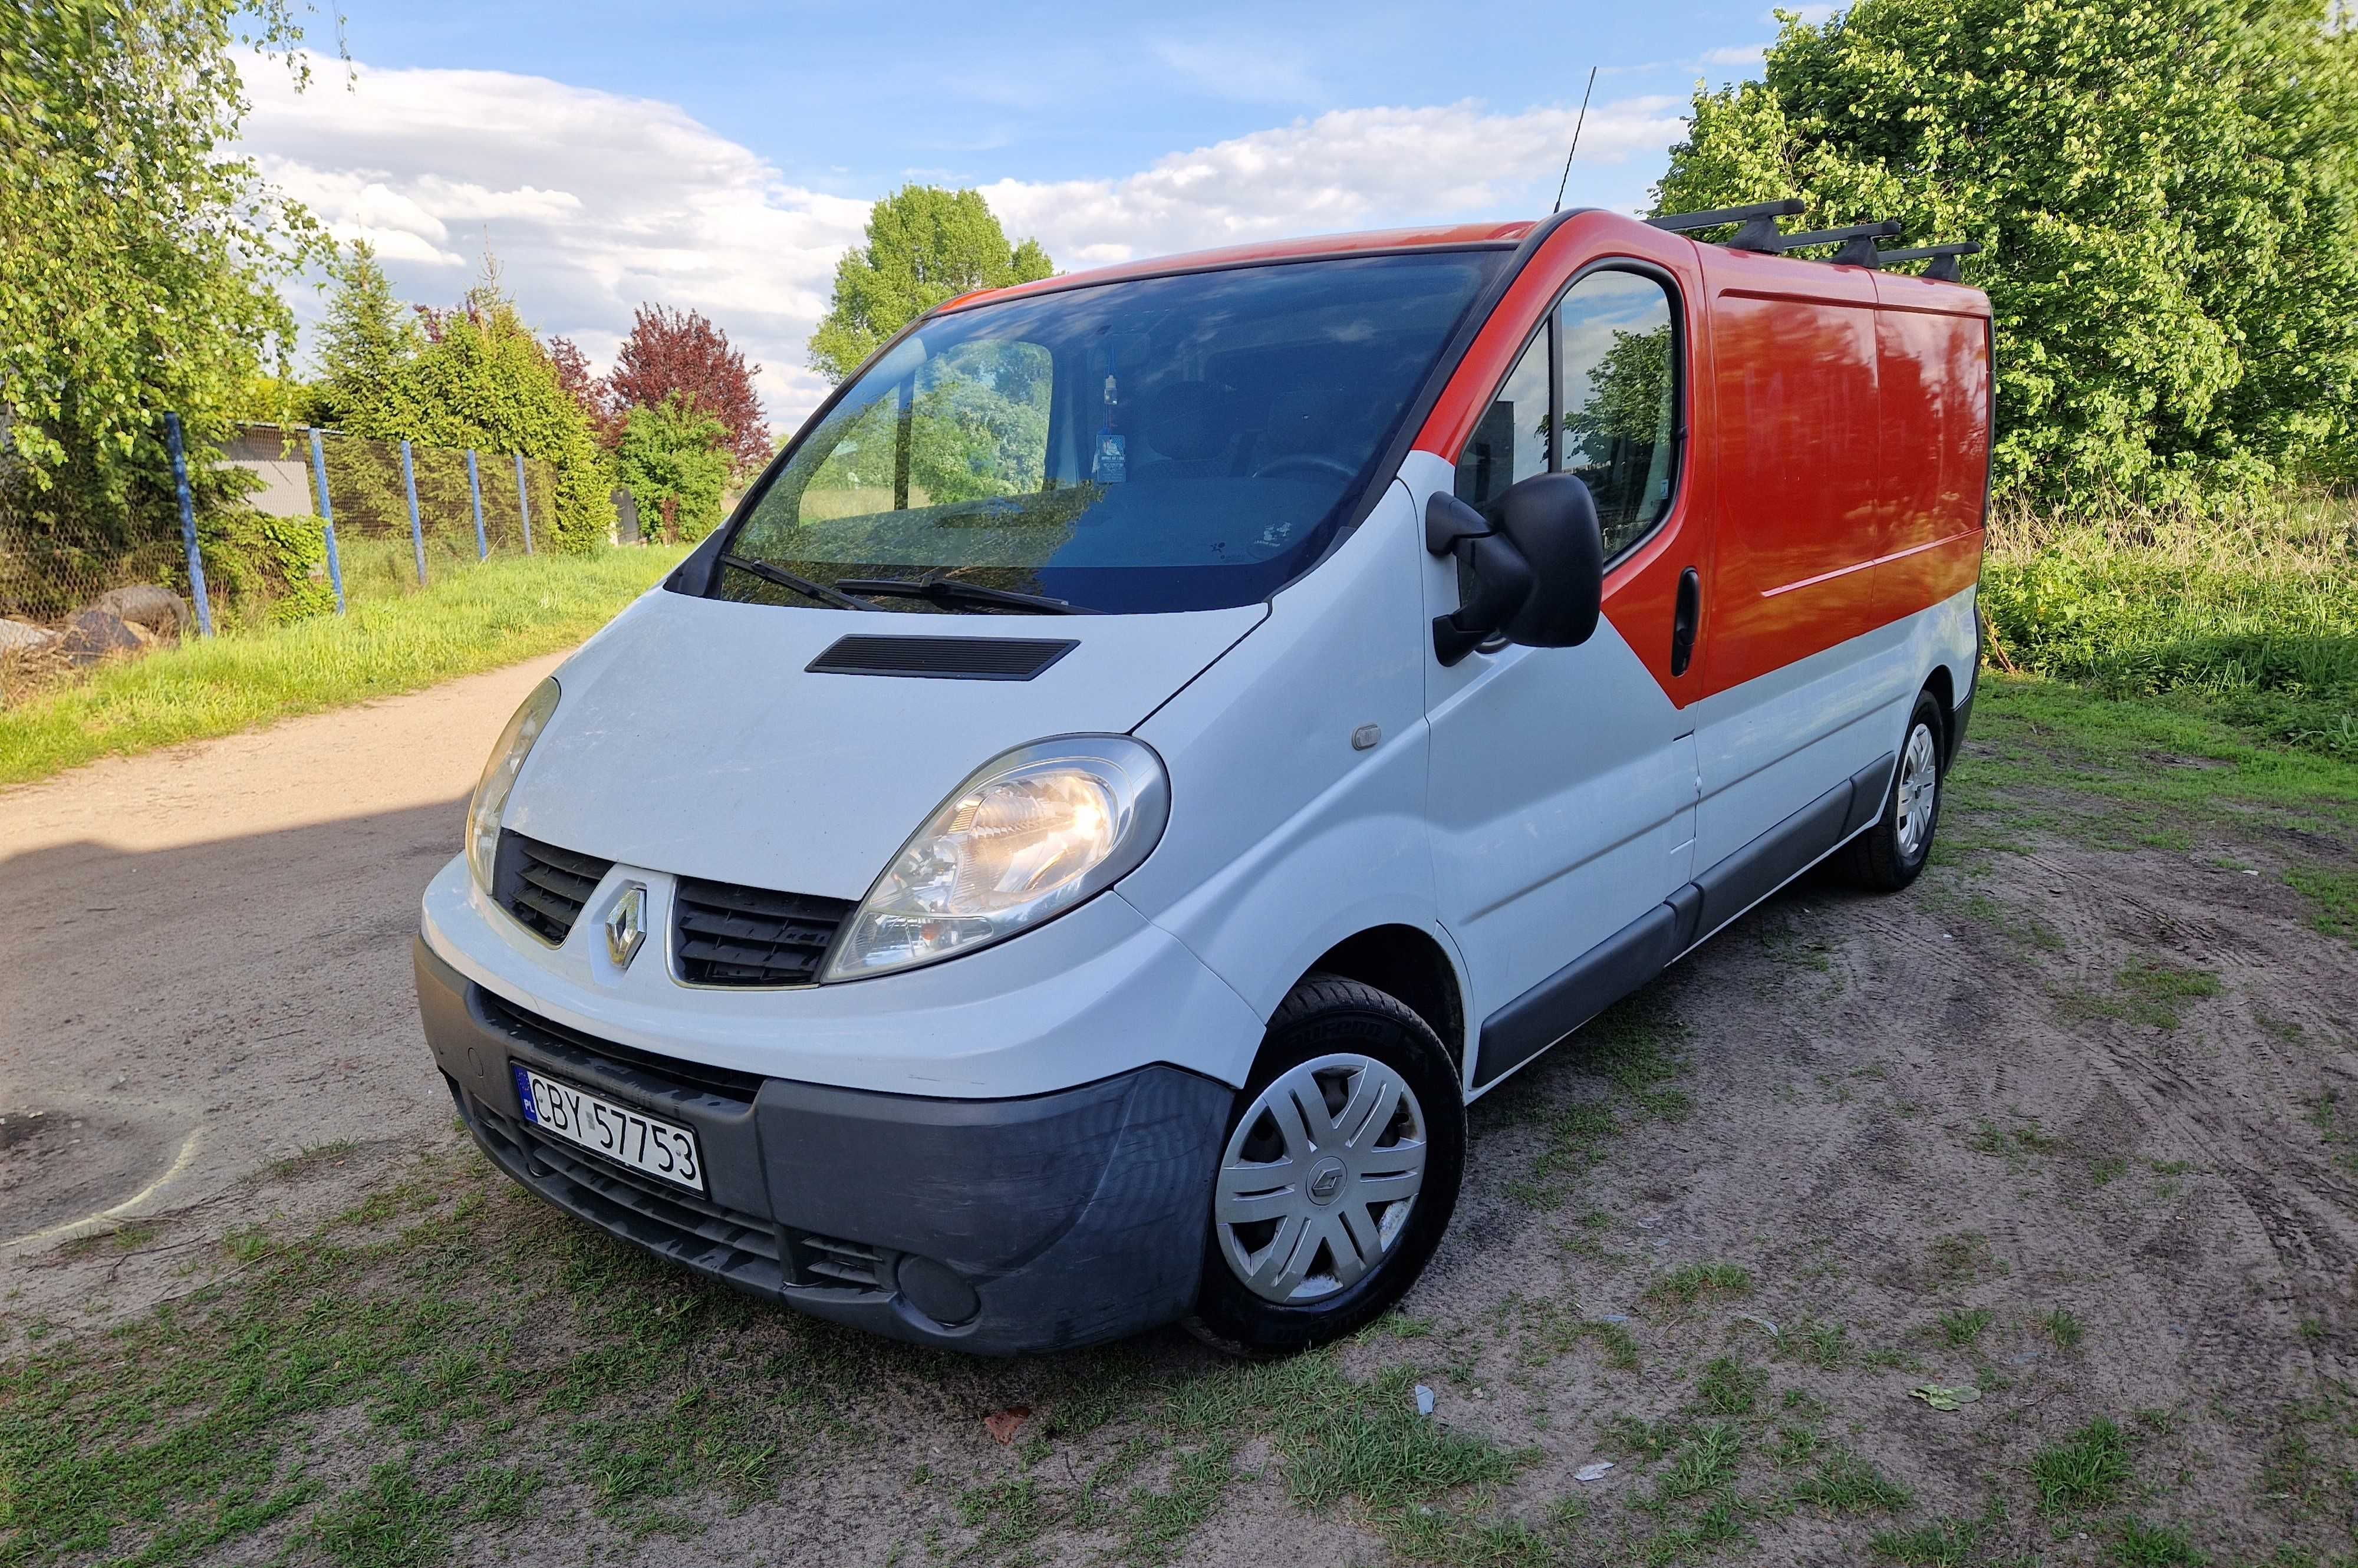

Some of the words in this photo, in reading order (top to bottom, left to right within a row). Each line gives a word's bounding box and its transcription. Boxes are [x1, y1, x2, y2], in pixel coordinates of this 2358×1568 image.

[523, 1099, 535, 1114] PL
[532, 1078, 582, 1138] CBY
[592, 1102, 697, 1181] 57753
